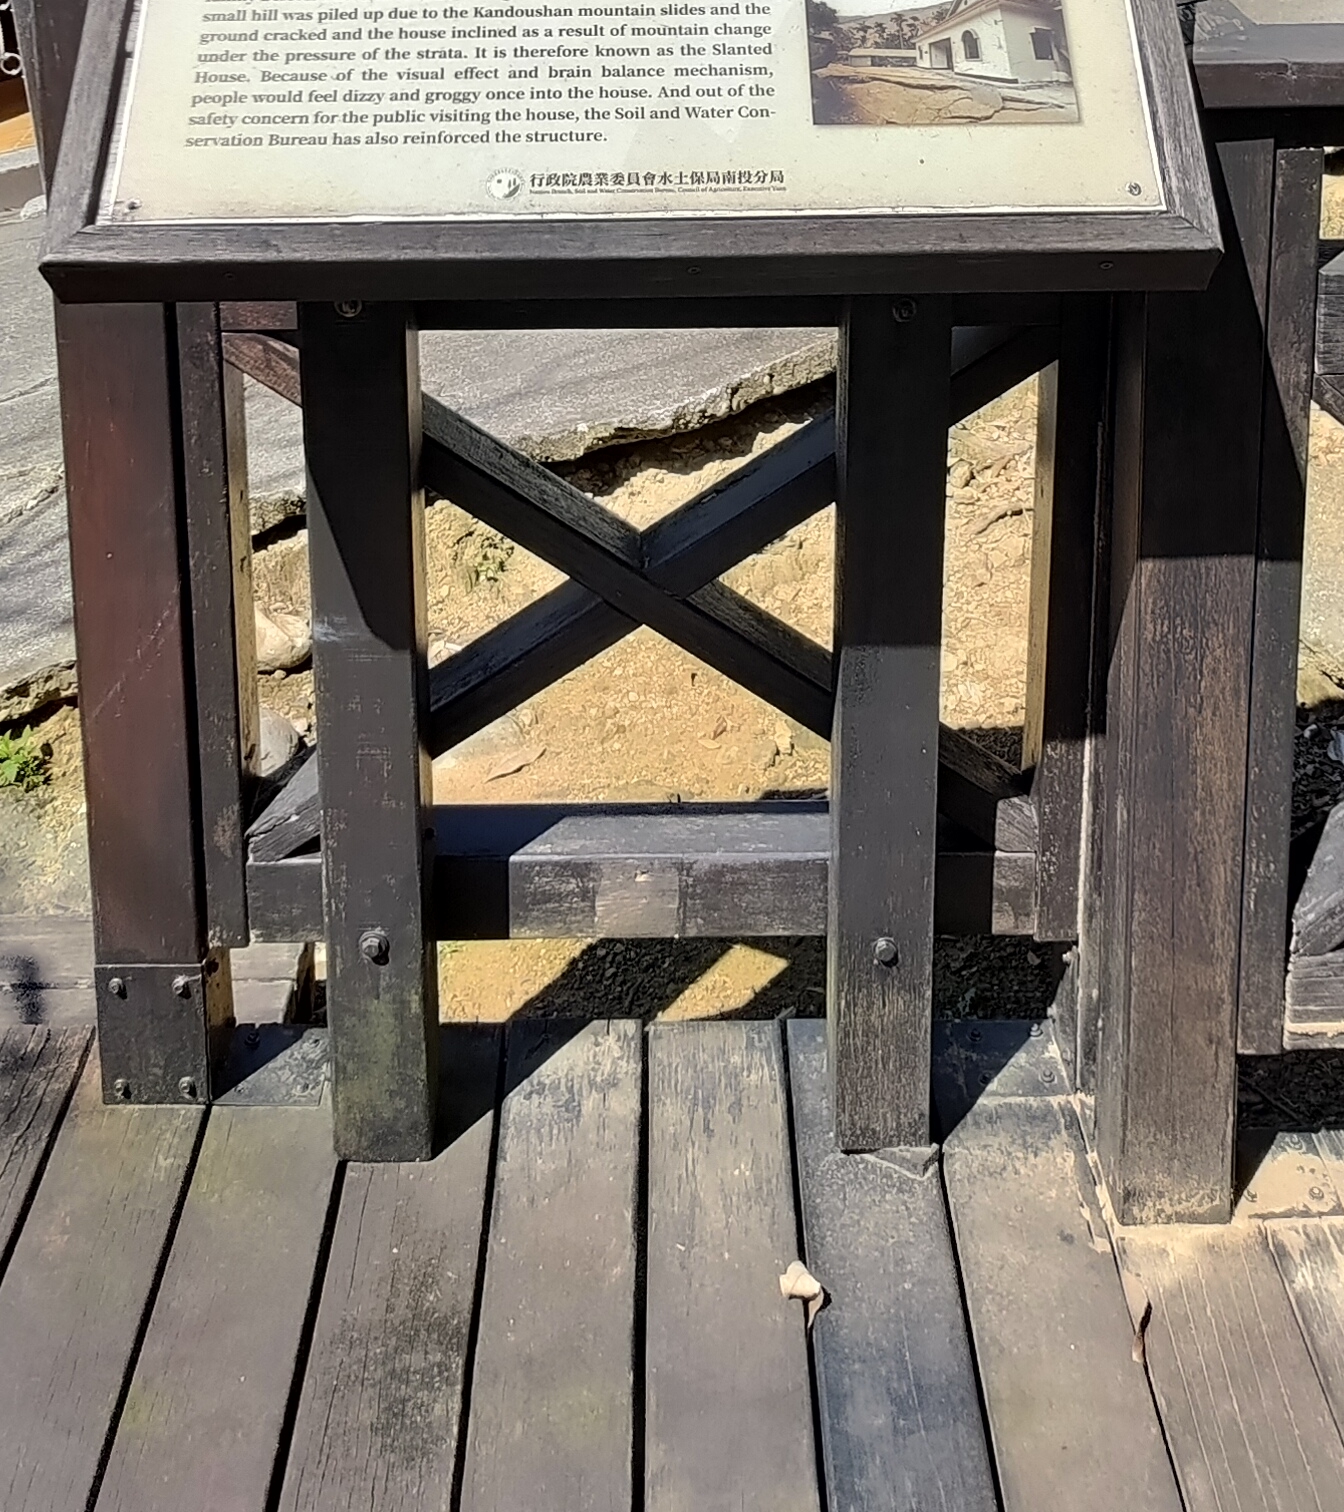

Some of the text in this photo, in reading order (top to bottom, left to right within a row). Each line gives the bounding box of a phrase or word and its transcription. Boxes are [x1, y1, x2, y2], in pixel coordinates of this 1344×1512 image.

[202, 1, 771, 24] small hill was piled up due to the Kandoushan mountain slides and the
[199, 21, 772, 46] ground cracked and the house inclined as a result of mountain change
[197, 41, 773, 65] under the pressure of the strata. It is therefore known as the Slanted
[194, 62, 774, 84] House. Because of the visual effect and brain balance mechanism,
[191, 83, 775, 108] people would feel dizzy and groggy once into the house. And out of the
[188, 104, 775, 129] safety concern for the public visiting the house, the Soil and Water Con-
[185, 128, 608, 147] servation Bureau has also reinforced the structure.
[529, 170, 785, 187] 行政院農業委員會水土保局南投分局
